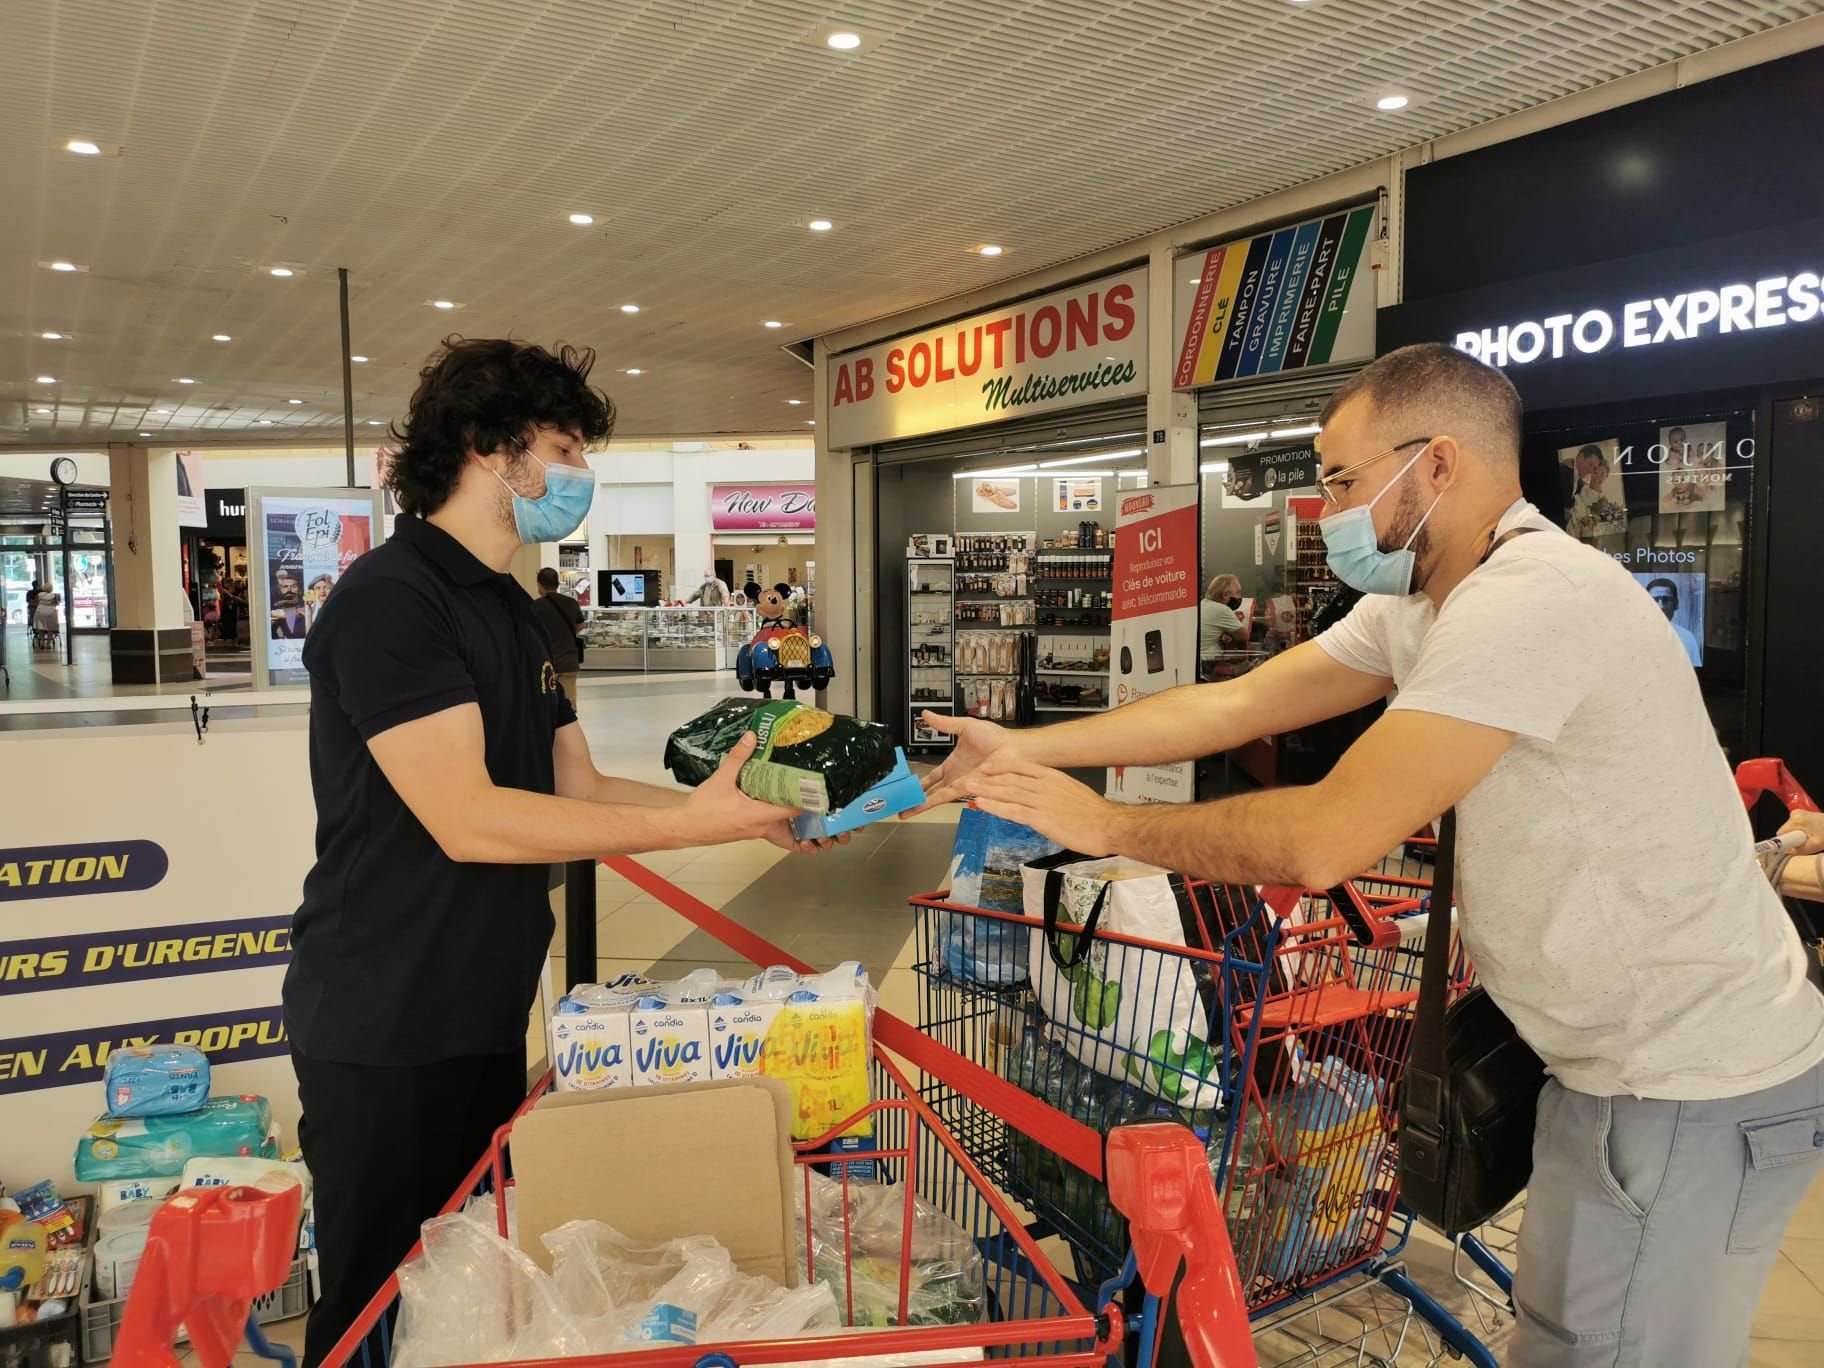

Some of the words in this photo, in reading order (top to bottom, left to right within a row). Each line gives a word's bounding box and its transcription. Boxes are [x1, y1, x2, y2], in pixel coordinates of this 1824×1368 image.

[1248, 258, 1283, 352] GRAVURE
[1268, 241, 1310, 359] IMPRIMERIE
[1292, 237, 1335, 353] FAIRE-PART
[1328, 267, 1350, 312] PILE
[1179, 251, 1222, 387] CORDONNERIE
[1213, 296, 1230, 334] CLÉ
[1228, 270, 1259, 351] TAMPON
[1456, 310, 1613, 367] PHOTO
[1623, 272, 1824, 349] EXPRES
[833, 357, 875, 407] AB
[885, 283, 1136, 394] SOLUTIONS
[982, 359, 1137, 412] Multiservices
[1260, 448, 1311, 465] PROMOTION
[1278, 470, 1286, 483] la
[1288, 467, 1305, 484] pile
[306, 509, 330, 527] Fol
[724, 491, 772, 513] New
[305, 525, 330, 548] Epi
[1139, 528, 1162, 553] ICI
[1636, 547, 1696, 563] Photos
[1142, 576, 1153, 588] de
[1155, 570, 1186, 584] voiture
[756, 712, 776, 750] FUSILLI
[0, 854, 129, 887] ATION
[0, 951, 69, 981] RS
[82, 927, 293, 972] D'URGENC
[575, 1023, 605, 1031] candia
[654, 1019, 683, 1027] candia
[733, 1015, 762, 1023] candia
[173, 1020, 288, 1052] POPU
[558, 1041, 623, 1077] Viva
[636, 1037, 702, 1073] Viva
[584, 1075, 612, 1086] VITAMINES
[120, 1187, 150, 1200] BABY
